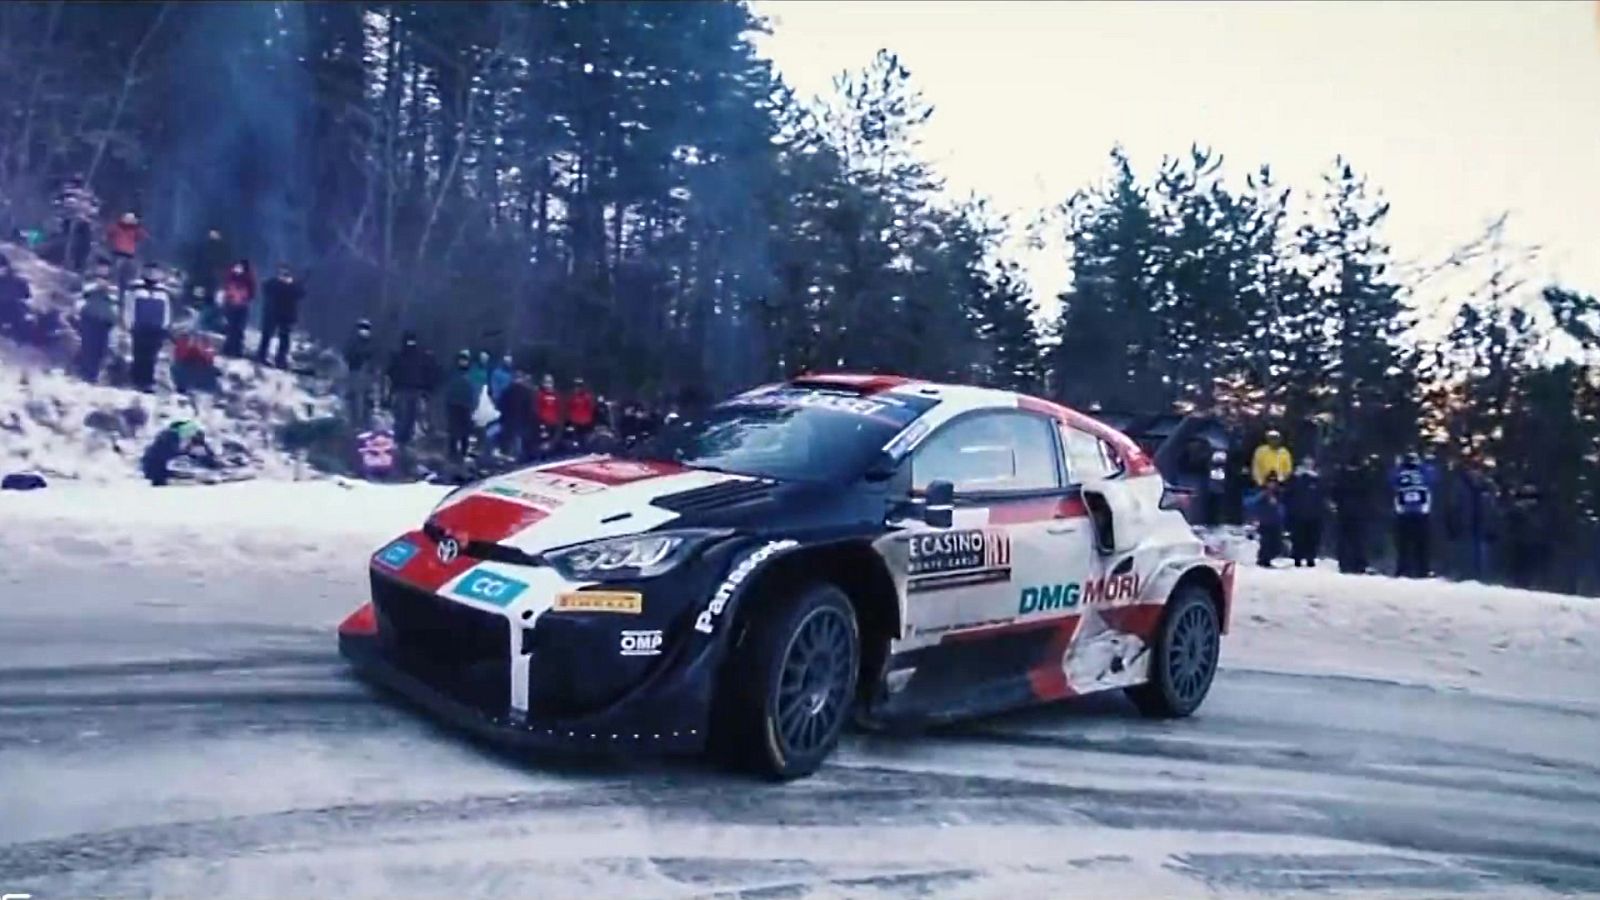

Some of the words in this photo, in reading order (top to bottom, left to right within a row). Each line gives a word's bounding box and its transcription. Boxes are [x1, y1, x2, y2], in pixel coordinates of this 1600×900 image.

[921, 531, 983, 556] CASINO
[1018, 582, 1080, 614] DMG
[1082, 572, 1141, 604] MORI
[620, 635, 663, 651] OMP
